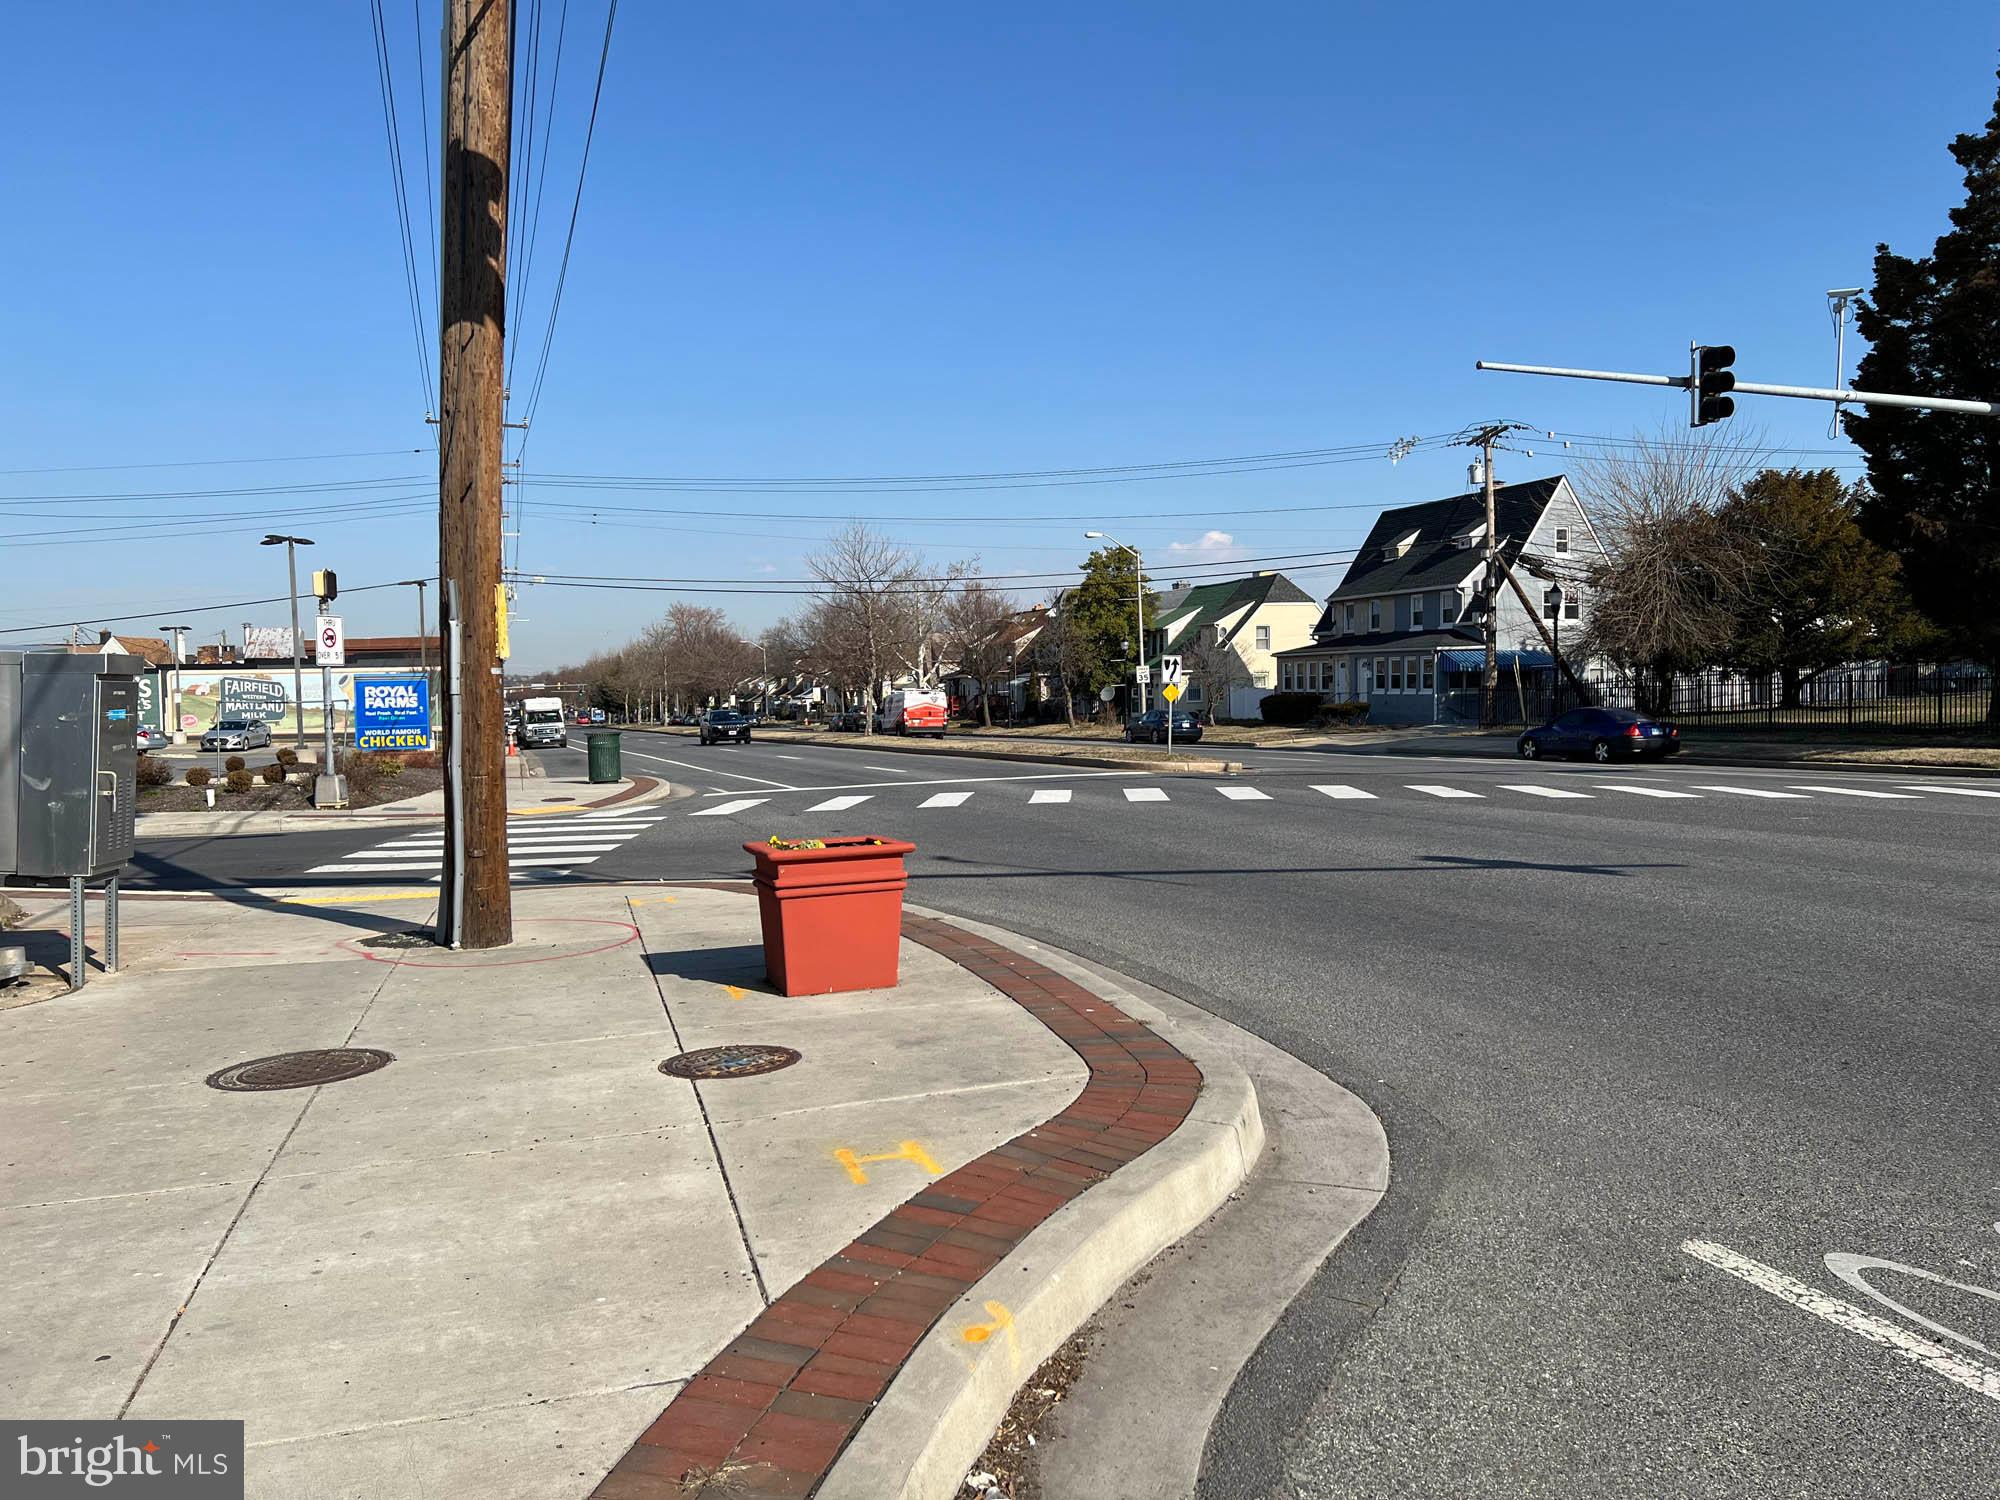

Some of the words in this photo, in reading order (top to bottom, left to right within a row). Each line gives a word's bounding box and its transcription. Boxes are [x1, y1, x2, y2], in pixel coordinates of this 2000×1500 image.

[224, 680, 283, 697] FAIRFIELD
[364, 686, 418, 697] ROYAL
[224, 697, 284, 713] MARYLAND
[364, 697, 418, 709] FARMS
[241, 711, 267, 719] MILK
[360, 735, 427, 748] CHICKEN
